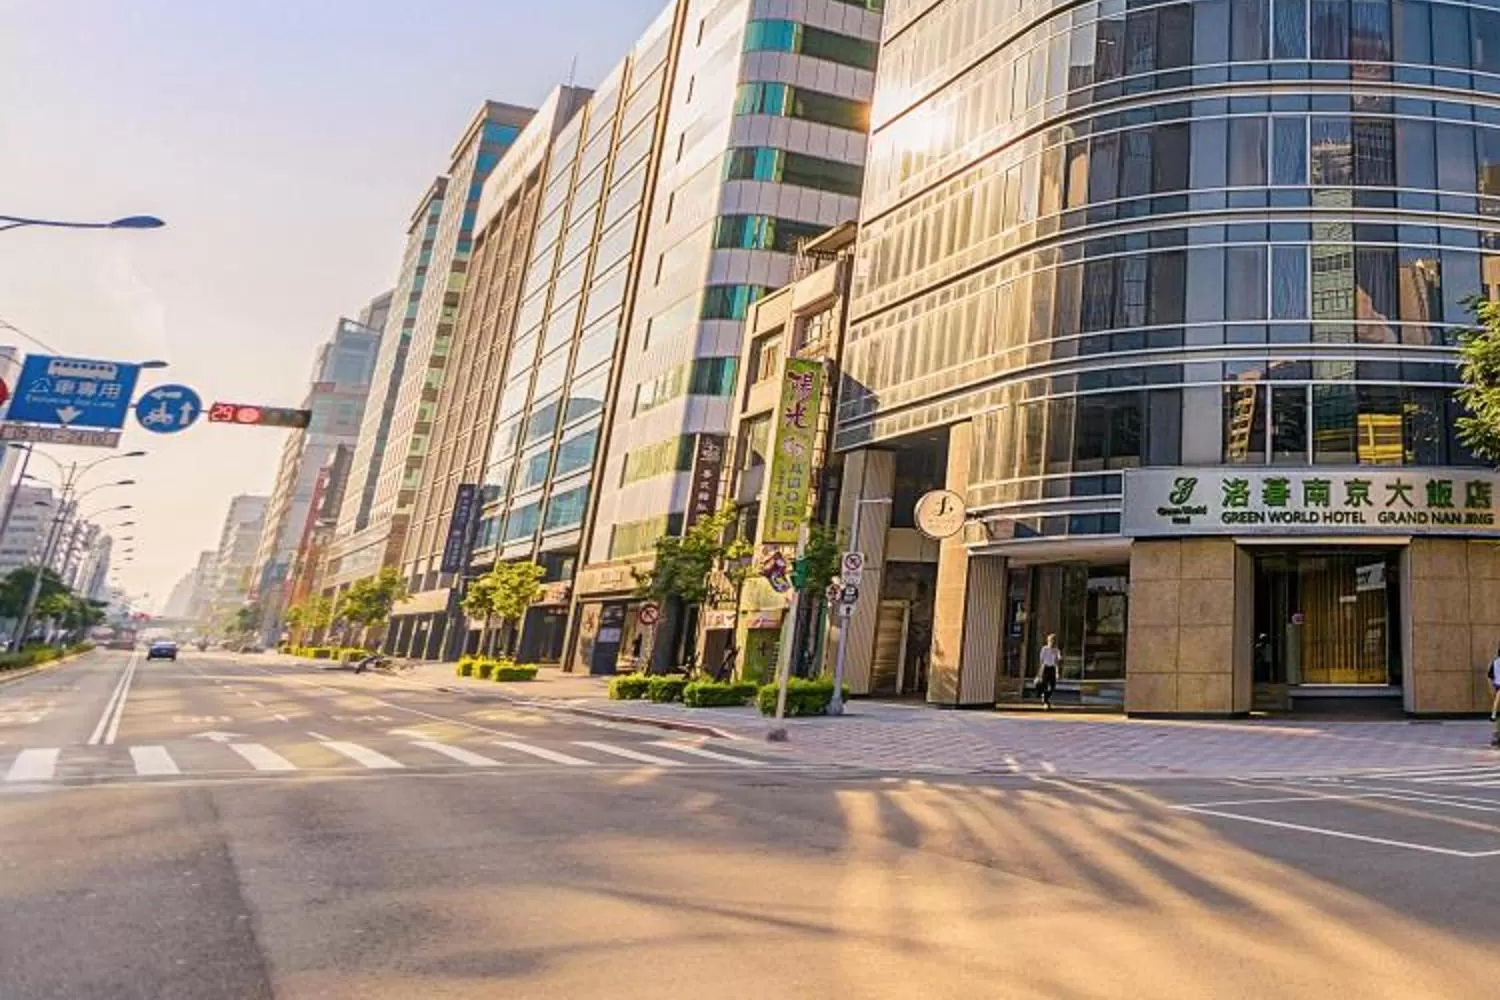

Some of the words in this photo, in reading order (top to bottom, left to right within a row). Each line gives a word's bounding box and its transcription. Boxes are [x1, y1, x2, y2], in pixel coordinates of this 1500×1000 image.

[1221, 477, 1493, 508] 洛碁南京大飯店
[1221, 511, 1265, 524] GREEN
[1267, 511, 1320, 524] WORLD
[1323, 511, 1367, 524] HOTEL
[1377, 511, 1429, 524] GRAND
